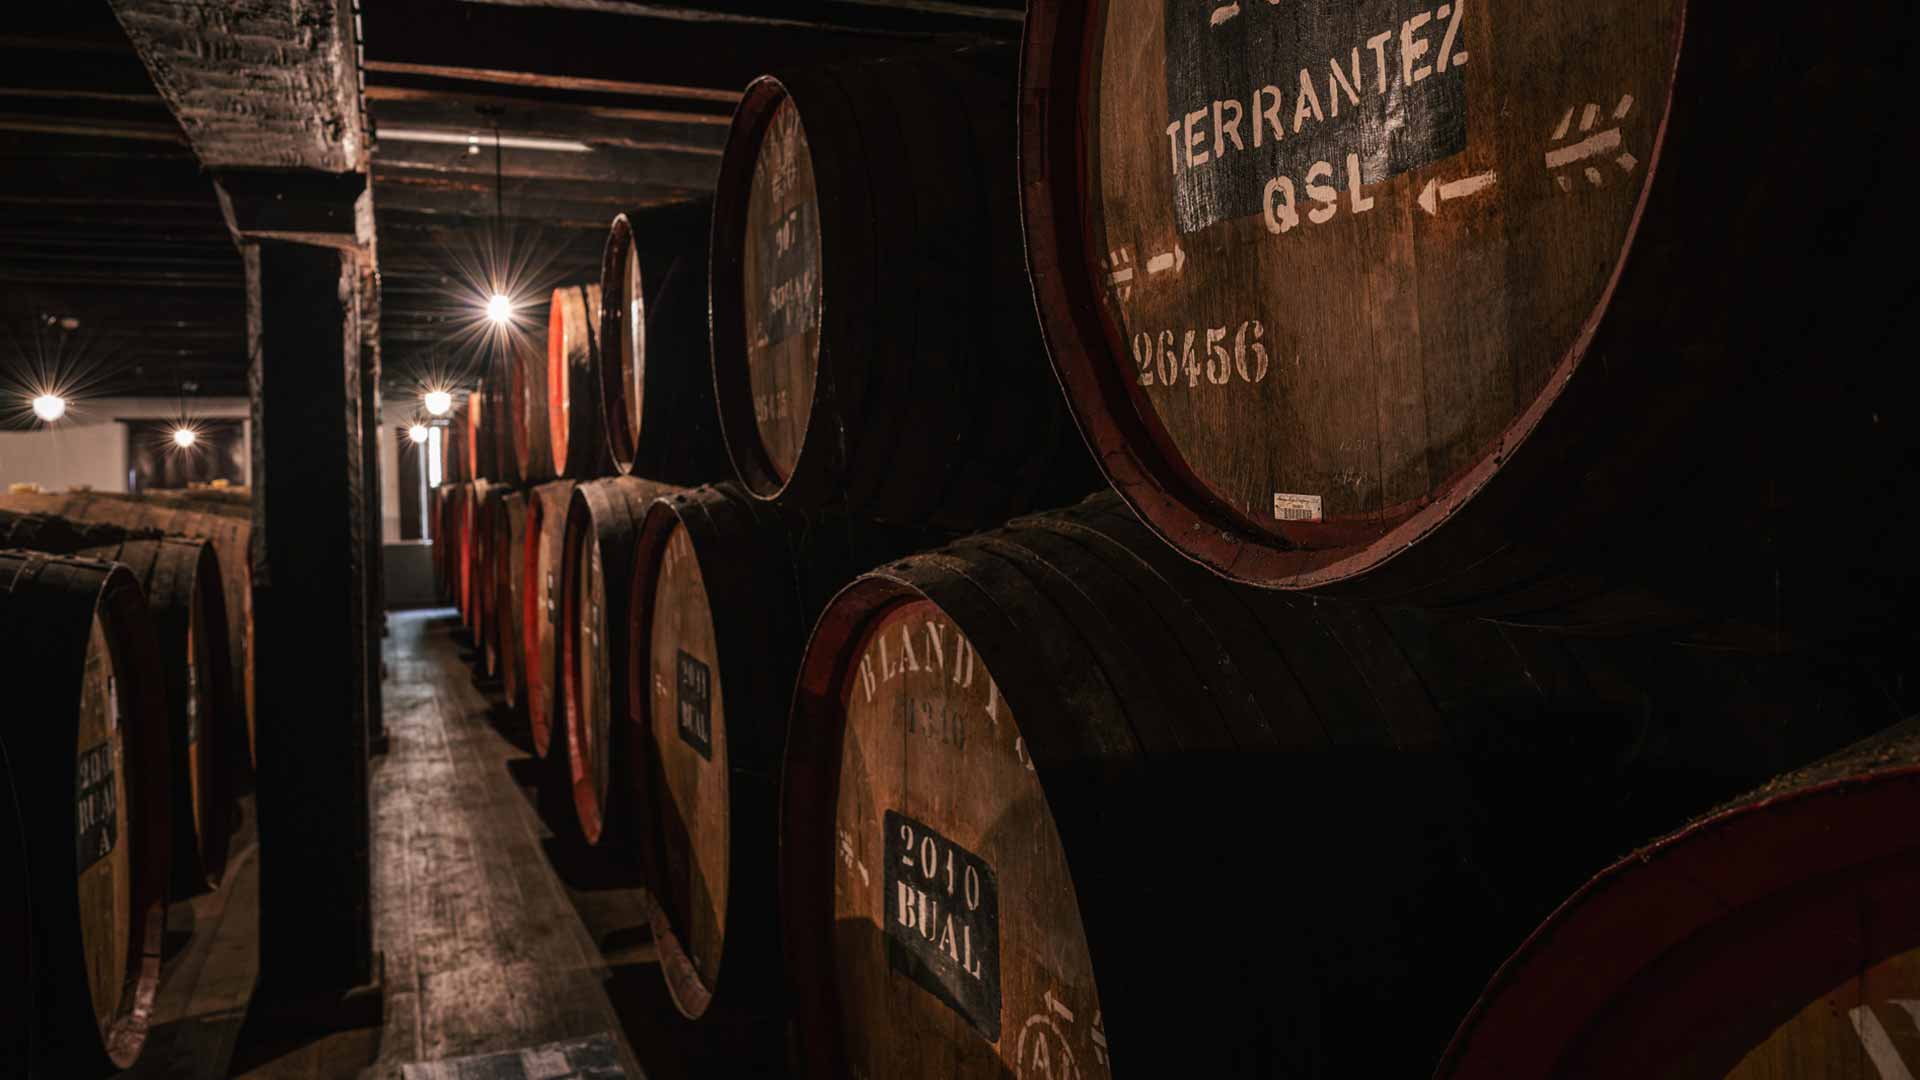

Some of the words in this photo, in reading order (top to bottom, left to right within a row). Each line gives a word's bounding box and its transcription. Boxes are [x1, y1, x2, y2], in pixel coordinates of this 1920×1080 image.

[1166, 0, 1470, 176] TERRANTEZ
[1263, 152, 1375, 234] QSL
[1132, 319, 1269, 388] 26456
[899, 824, 980, 912] 2010
[897, 880, 982, 981] BUAL
